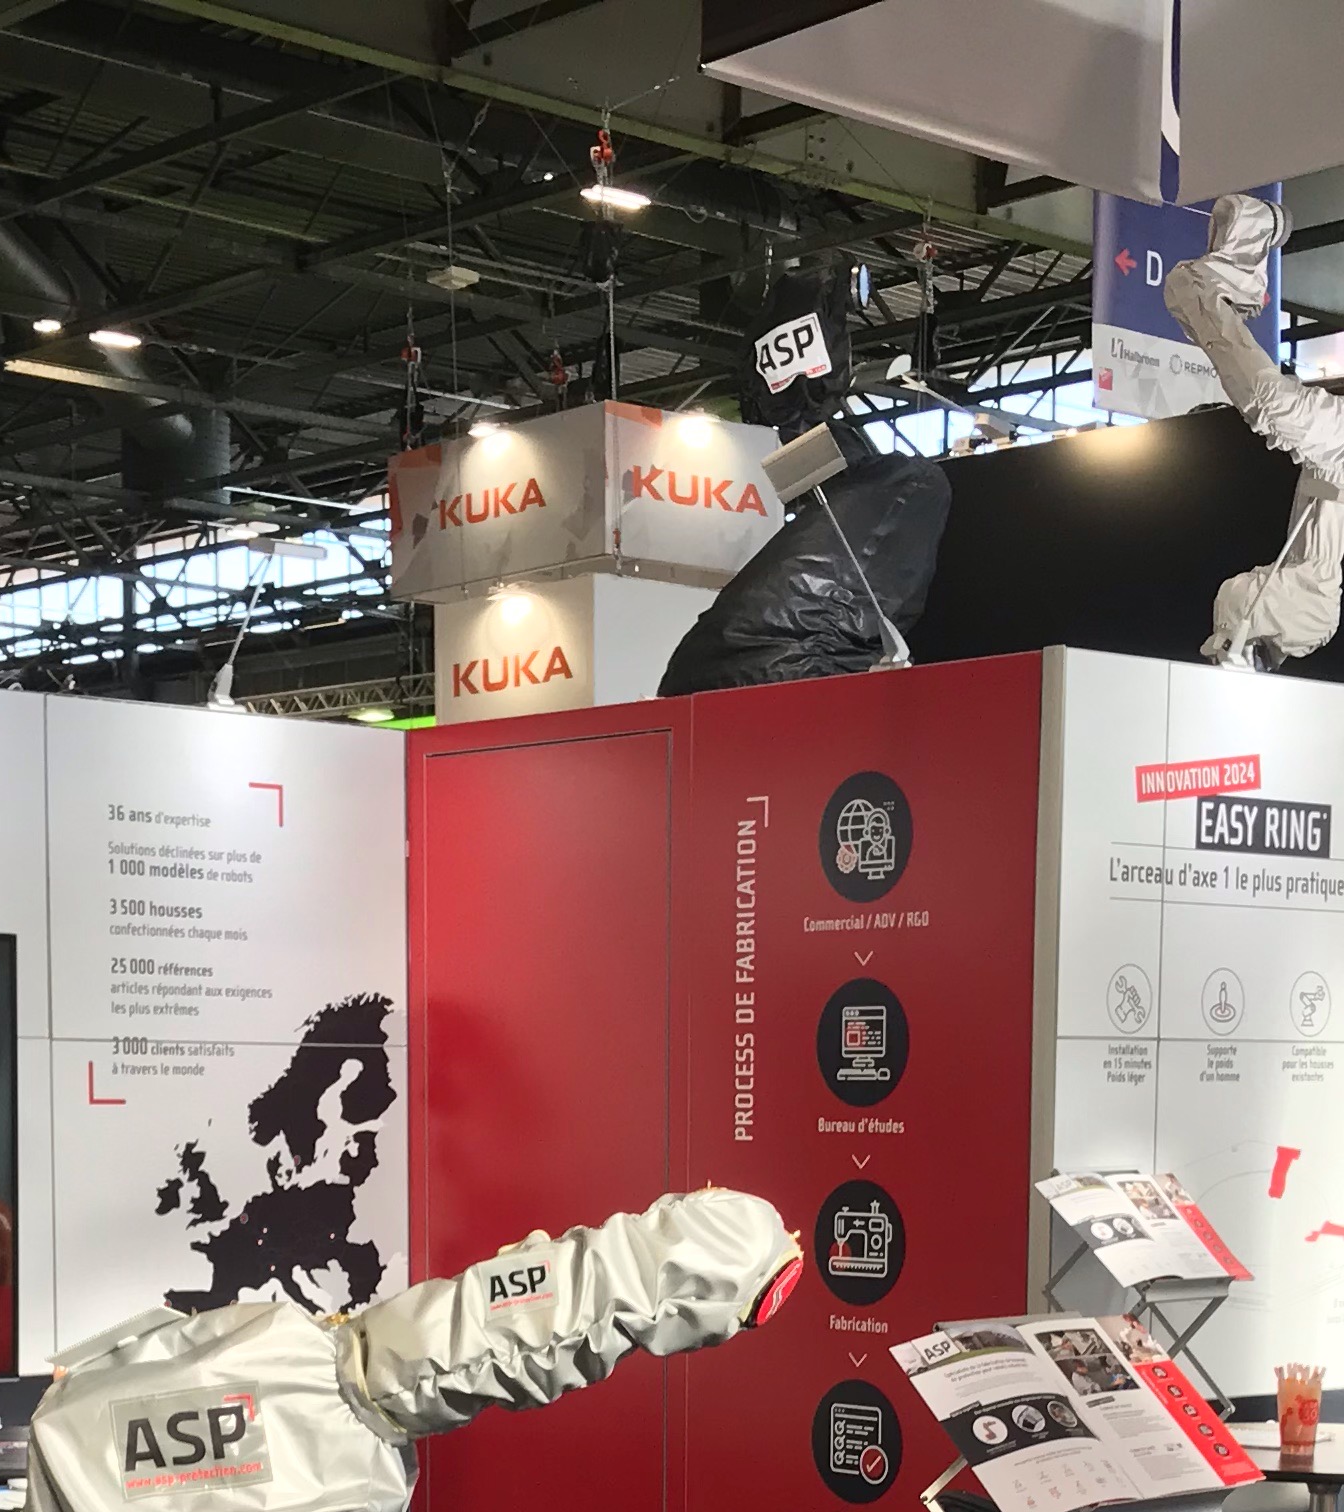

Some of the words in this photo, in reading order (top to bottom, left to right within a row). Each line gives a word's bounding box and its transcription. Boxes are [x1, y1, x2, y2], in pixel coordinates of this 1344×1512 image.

[1146, 250, 1163, 286] D
[759, 324, 814, 374] ASP
[438, 477, 546, 530] KUKA
[632, 465, 769, 518] KUKA
[453, 646, 573, 697] KUKA
[1141, 767, 1220, 795] INNOVATION
[1223, 761, 1256, 786] 2024
[108, 804, 125, 822] 36
[128, 810, 152, 823] ans
[154, 811, 212, 829] d'expertise
[1200, 800, 1258, 847] EASY
[108, 841, 156, 857] Solutions
[159, 845, 205, 861] déclinées
[208, 850, 224, 861] sur
[226, 849, 247, 864] plus
[249, 851, 262, 863] de
[108, 859, 114, 874] 1
[120, 860, 145, 876] 000
[149, 863, 204, 880] modèles
[206, 869, 218, 881] de
[221, 870, 253, 883] robots
[1108, 857, 1174, 885] L'arceau
[1178, 863, 1218, 889] d'axe
[1223, 865, 1230, 889] 1
[1235, 867, 1248, 890] le
[1252, 869, 1282, 898] plus
[1286, 872, 1344, 902] pratique
[109, 898, 117, 915] 3
[120, 899, 145, 916] 500
[149, 901, 203, 919] housses
[735, 819, 757, 985] FABRICATION
[109, 923, 186, 938] confectionnées
[187, 926, 222, 942] chaque
[224, 928, 248, 941] mois
[803, 914, 864, 933] Commercial
[111, 957, 127, 974] 25
[130, 958, 155, 975] 000
[158, 963, 213, 977] références
[110, 982, 150, 995] articles
[152, 982, 203, 998] répondant
[205, 986, 223, 997] aux
[225, 985, 273, 1001] exigences
[735, 991, 755, 1025] DE
[111, 1001, 126, 1014] les
[128, 1002, 151, 1017] plus
[153, 1003, 200, 1016] extrêmes
[734, 1032, 755, 1141] PROCESS
[818, 1116, 855, 1134] Bureau
[858, 1116, 905, 1135] d'études
[490, 1265, 546, 1303] ASP
[829, 1316, 888, 1334] Fabrication
[923, 1341, 951, 1361] ASP
[125, 1404, 246, 1472] ASP
